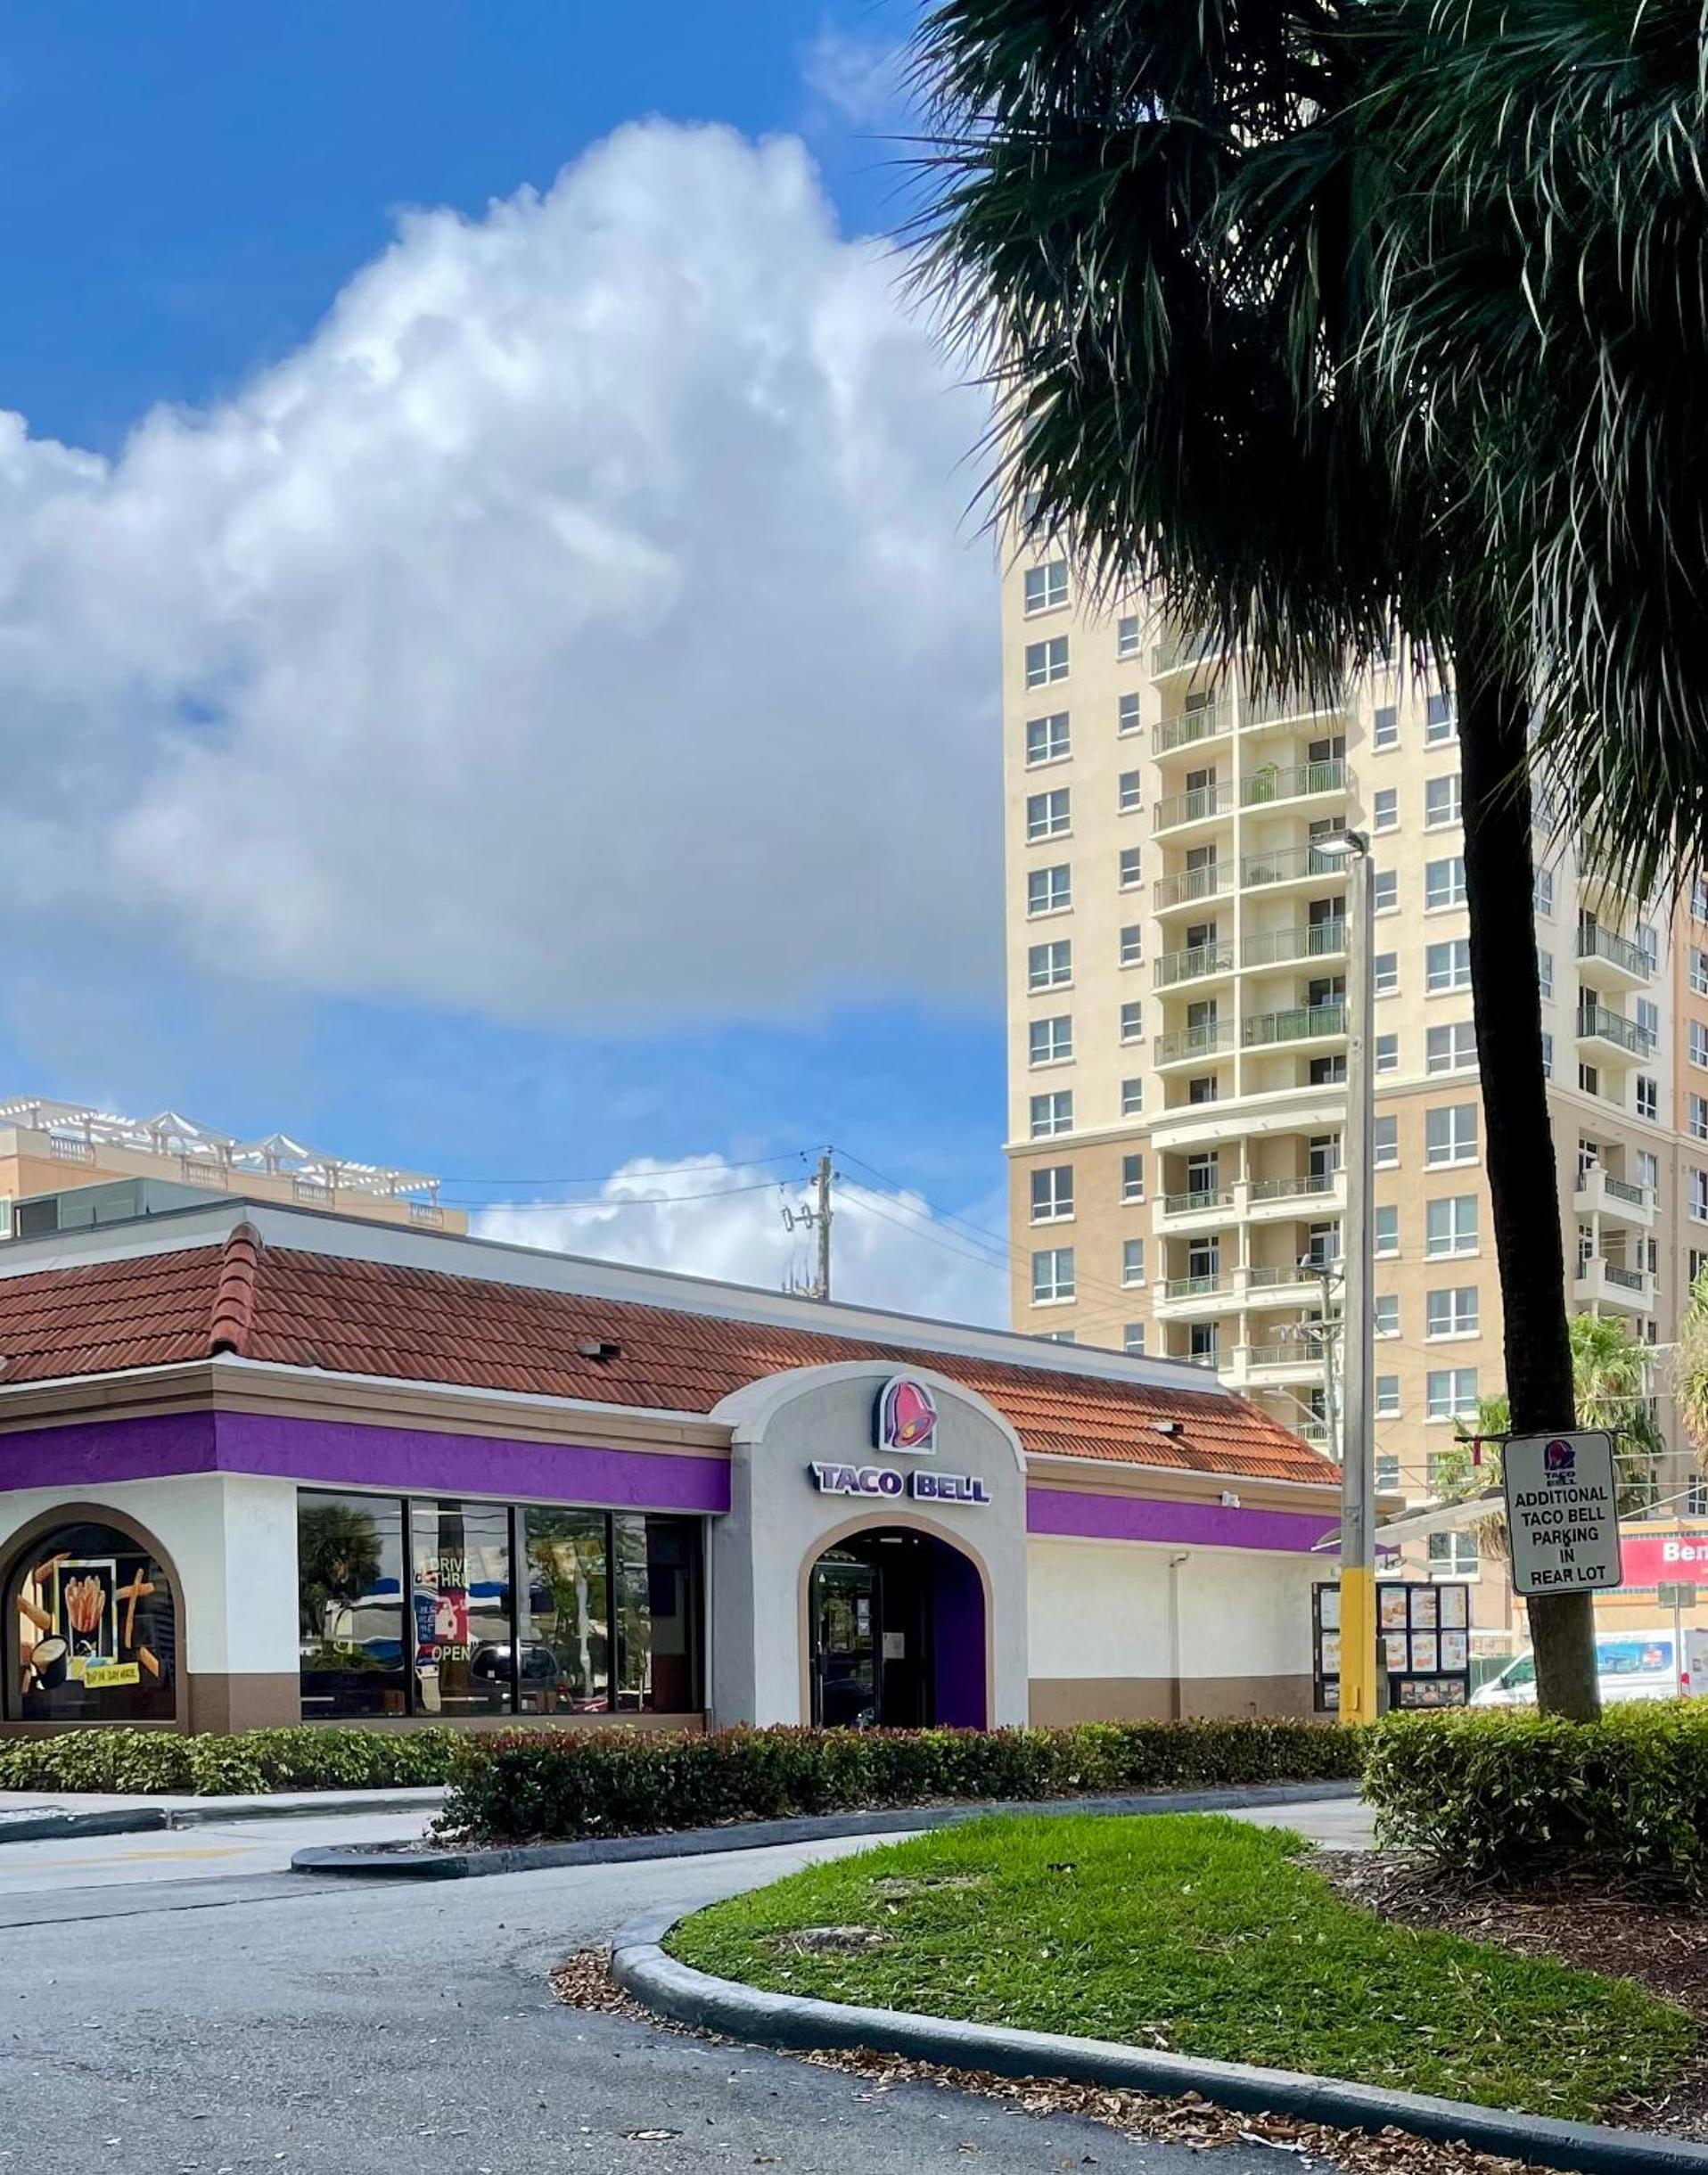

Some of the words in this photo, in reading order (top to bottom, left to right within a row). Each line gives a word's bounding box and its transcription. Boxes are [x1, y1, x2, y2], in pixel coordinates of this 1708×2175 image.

[814, 1463, 902, 1498] TACO
[915, 1472, 991, 1505] BELL
[1547, 1478, 1578, 1487] BELL
[1515, 1487, 1608, 1507] ADDITIONAL
[1521, 1510, 1564, 1527] TACO
[1568, 1507, 1605, 1523] BELL
[1532, 1527, 1598, 1546] PARKING
[429, 1556, 471, 1572] DRIVE
[1560, 1548, 1575, 1563] IN
[433, 1572, 471, 1589] THRU
[1531, 1569, 1573, 1586] REAR
[1578, 1566, 1605, 1581] LOT
[431, 1646, 471, 1661] OPEN
